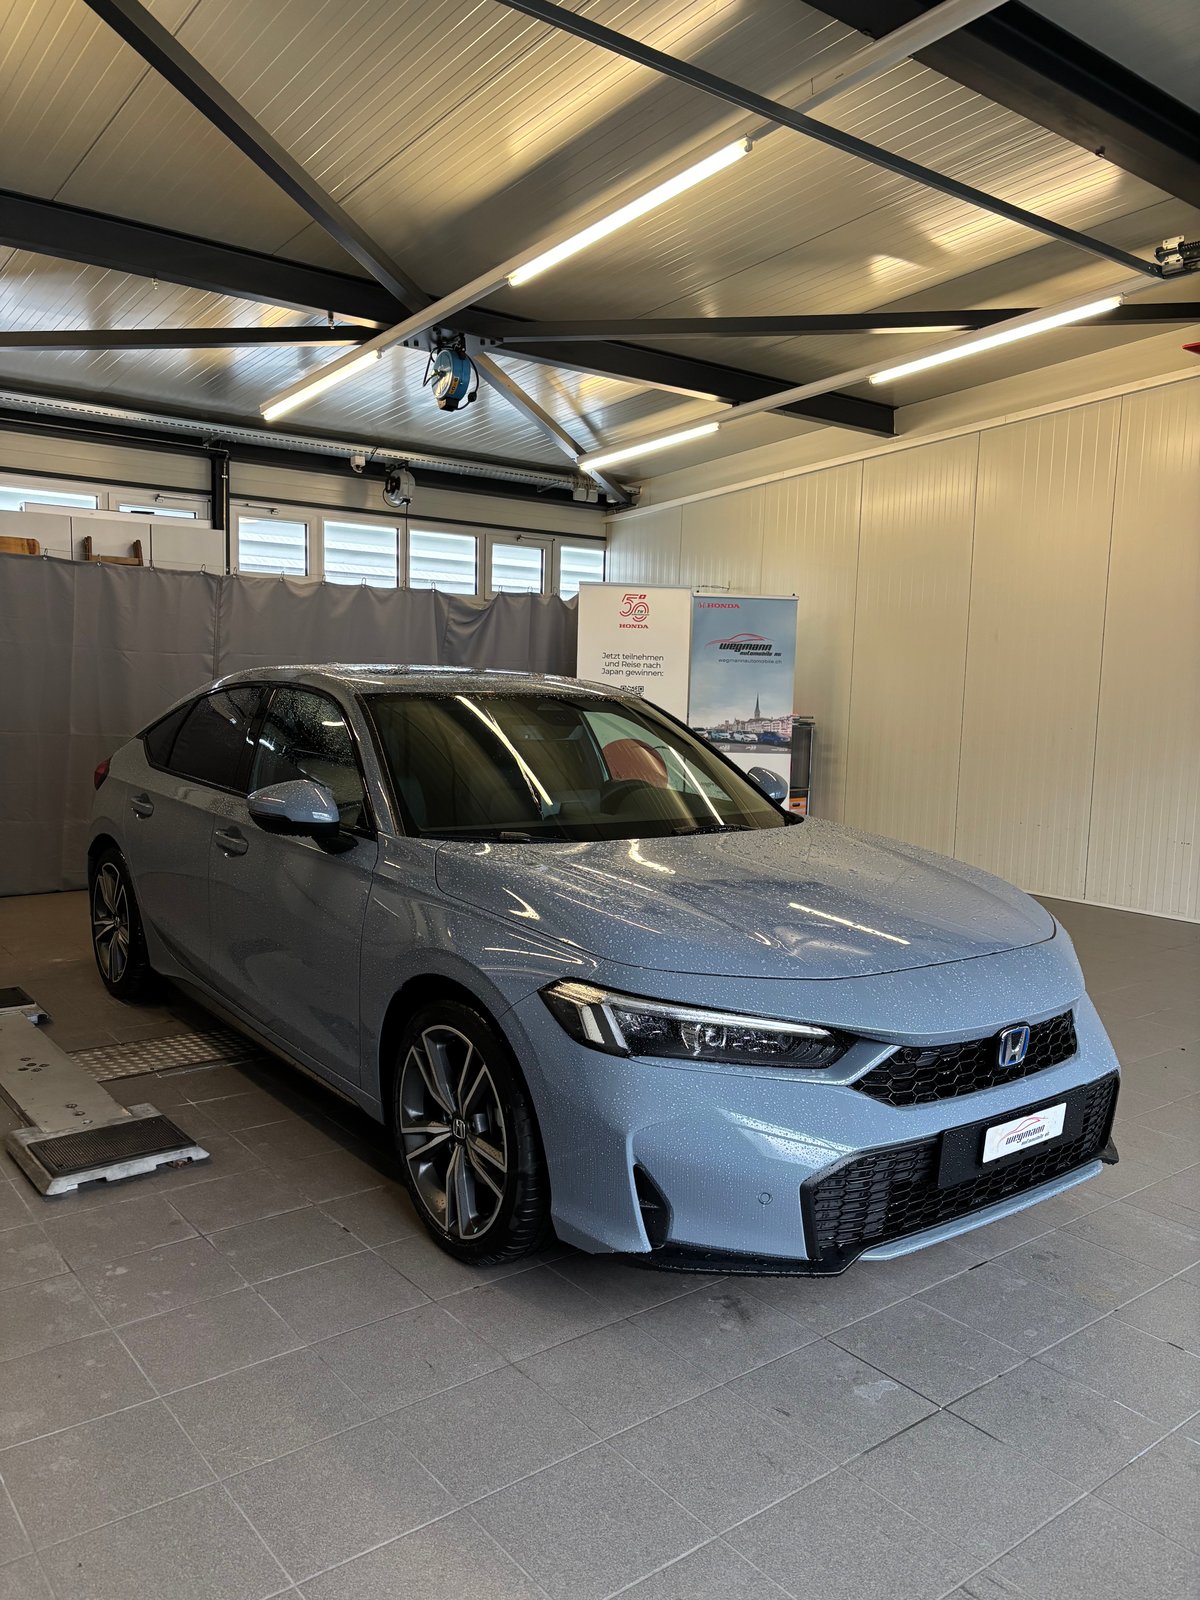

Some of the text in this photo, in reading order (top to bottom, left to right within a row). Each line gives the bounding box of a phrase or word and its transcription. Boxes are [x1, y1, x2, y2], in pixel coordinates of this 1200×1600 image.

[718, 642, 773, 653] wegmann
[601, 652, 664, 661] Jetzt teilnehmen
[604, 660, 620, 668] und
[621, 660, 642, 669] Reise
[601, 668, 664, 677] Japan gewinnen:
